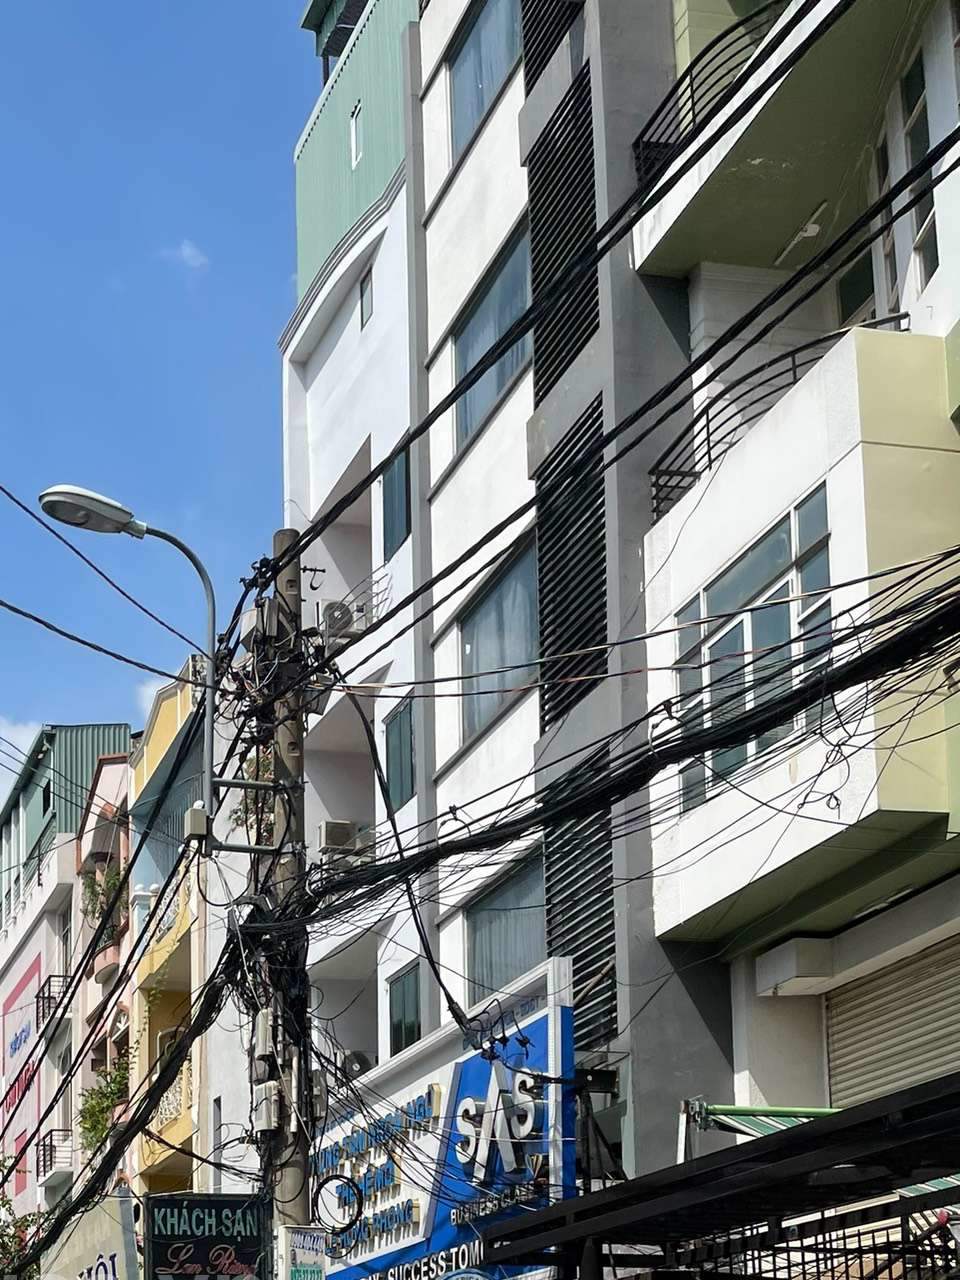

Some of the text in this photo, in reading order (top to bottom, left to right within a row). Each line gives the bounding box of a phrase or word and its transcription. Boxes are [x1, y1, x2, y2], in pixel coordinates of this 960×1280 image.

[455, 1060, 536, 1182] SAS
[154, 1201, 258, 1241] KHÁCH SẠN
